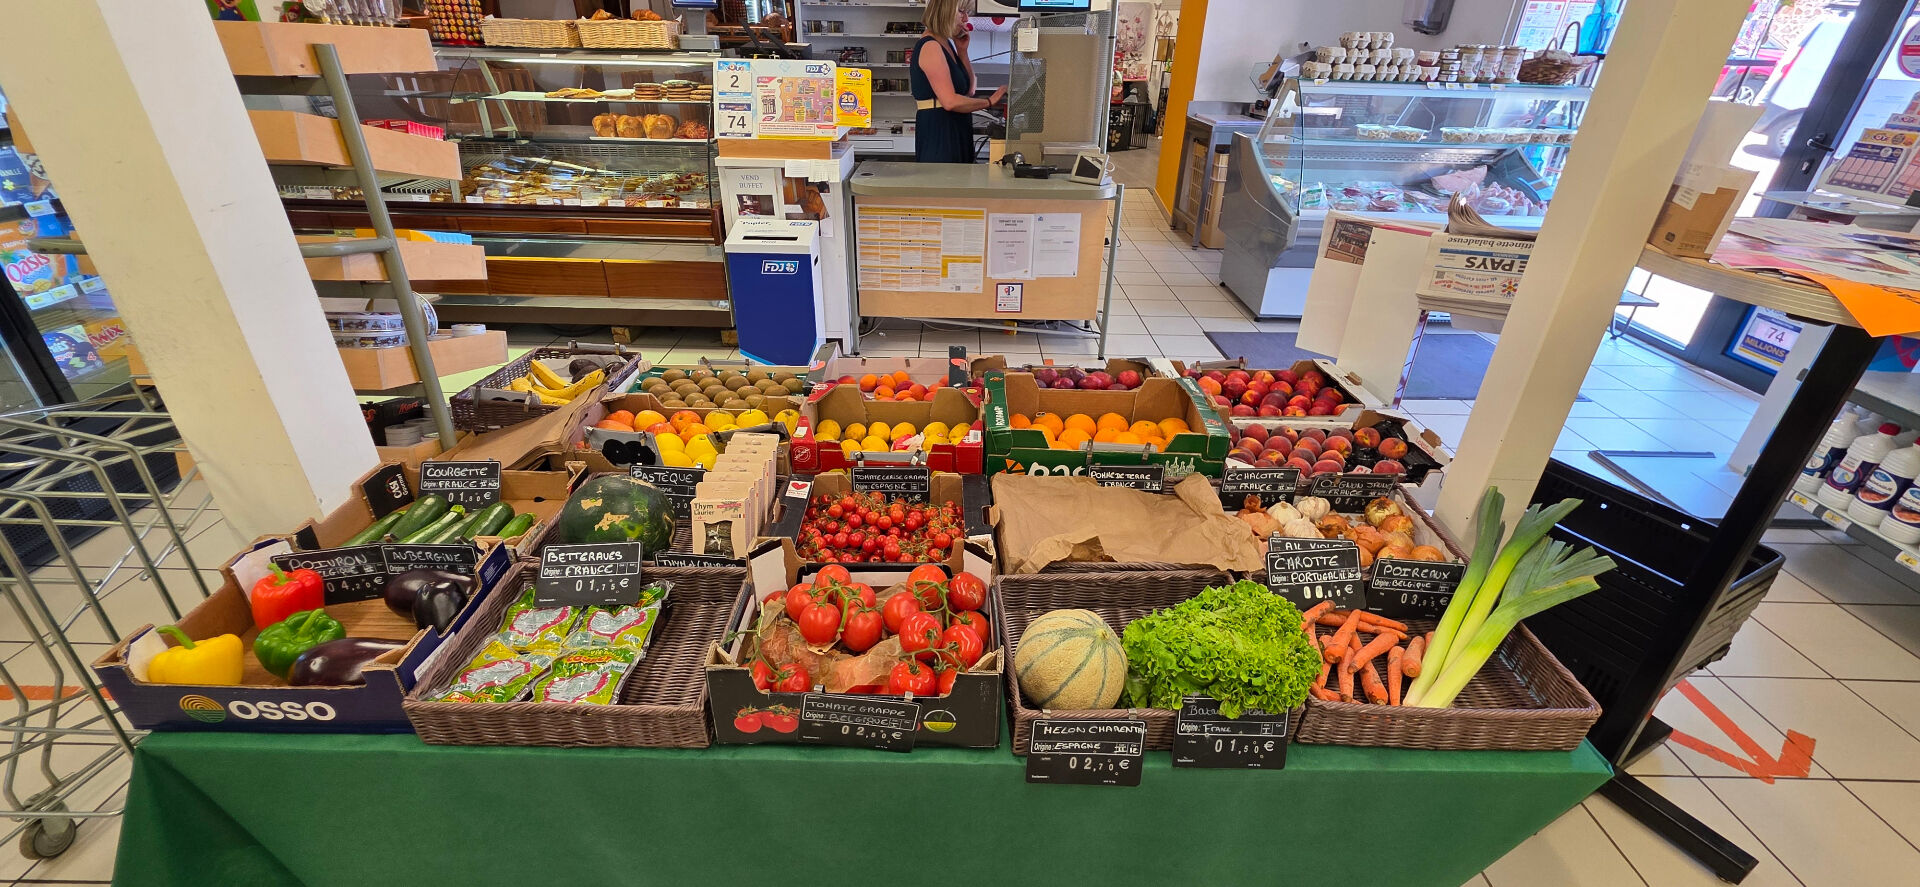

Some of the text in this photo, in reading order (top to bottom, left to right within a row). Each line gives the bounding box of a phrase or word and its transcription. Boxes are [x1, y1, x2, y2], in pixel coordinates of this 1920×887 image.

[730, 74, 740, 89] 2
[841, 94, 856, 103] 20
[727, 115, 747, 129] 74
[1447, 236, 1494, 248] baladeuse
[7, 252, 50, 282] Oasis
[764, 263, 785, 273] FDJ
[1464, 255, 1516, 274] PAYS
[1766, 326, 1787, 344] 74
[1744, 337, 1787, 358] MILLIONS
[427, 466, 488, 478] COURGETTE
[438, 480, 477, 489] FRANCE
[1239, 483, 1273, 491] FRANCE
[693, 502, 714, 511] Thym
[693, 510, 715, 518] Laurier
[392, 551, 463, 563] AUBERGINE
[1274, 555, 1340, 570] CAROTTE
[565, 564, 613, 577] FRANCE
[1383, 564, 1451, 580] POIREAUX
[1290, 571, 1339, 583] PORTUGAL
[228, 700, 337, 721] OSSO
[807, 701, 907, 717] TOMATE GRAPPE
[829, 713, 889, 726] BELGIQUE
[1043, 726, 1086, 736] MELON
[1053, 742, 1102, 751] ESPAGNE
[1263, 740, 1275, 752] €
[1118, 758, 1131, 770] €
